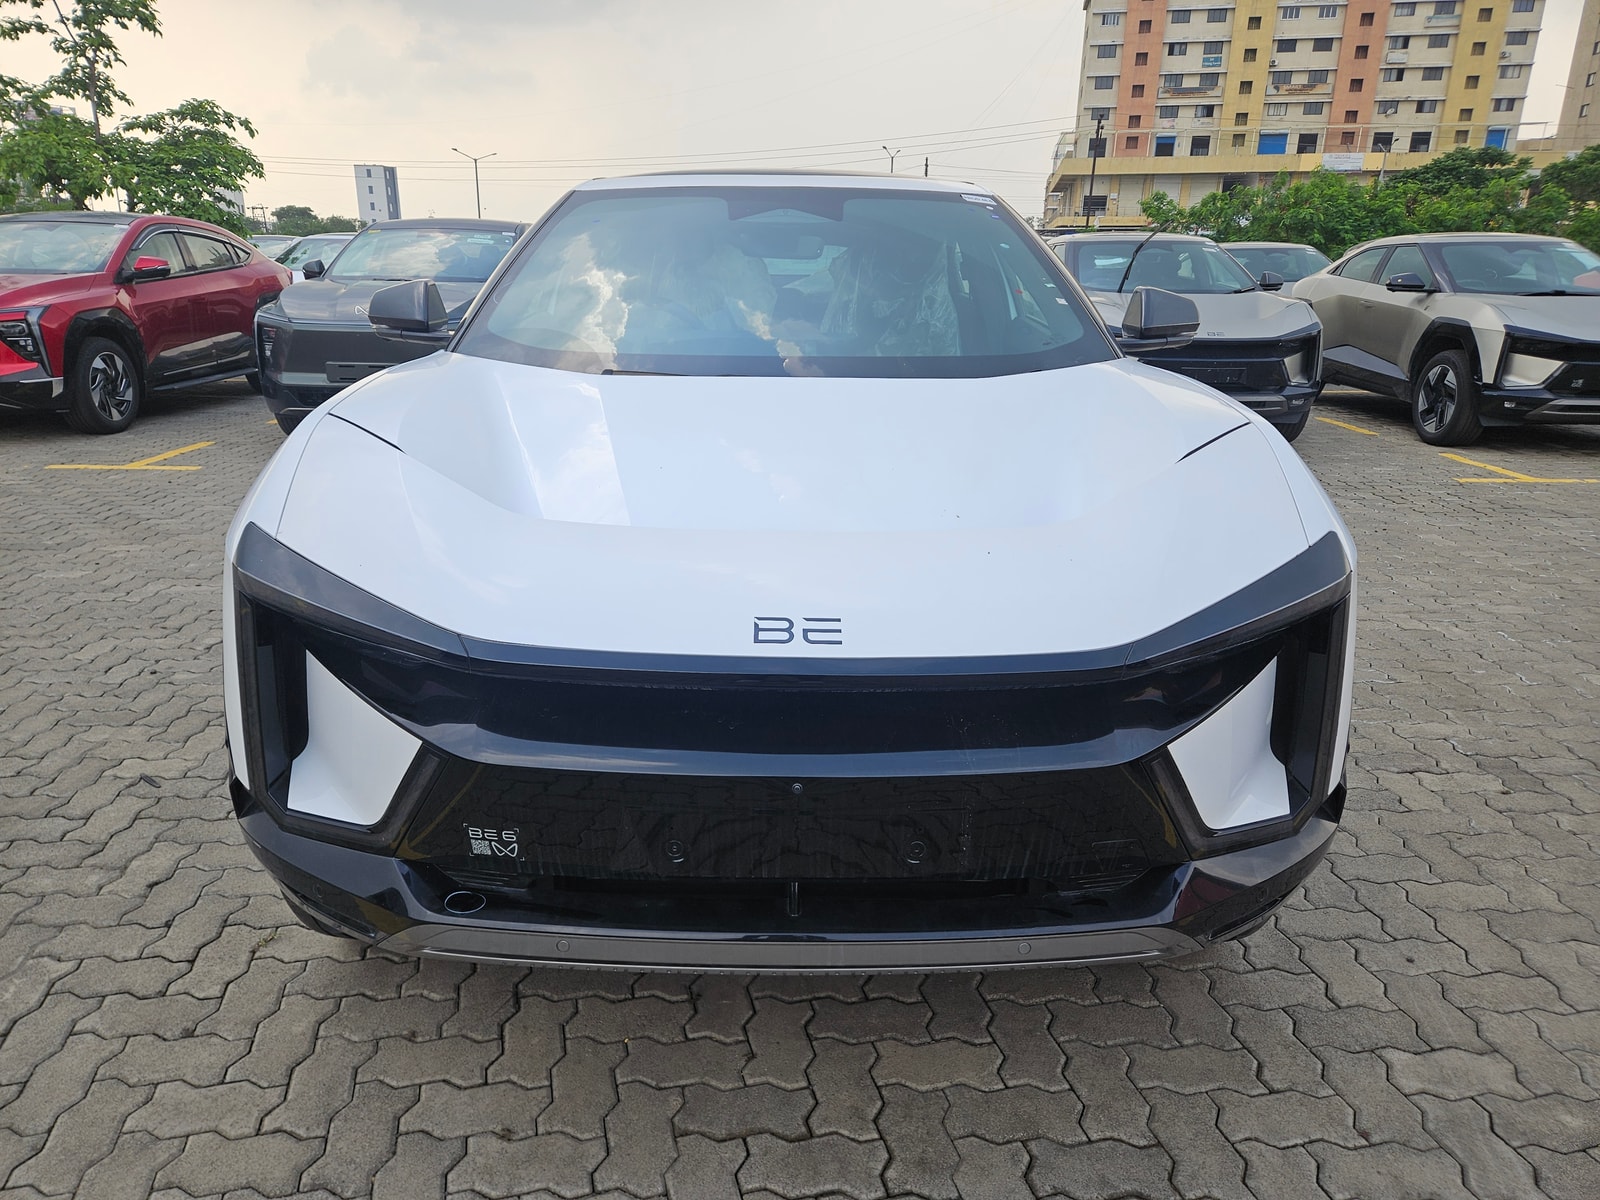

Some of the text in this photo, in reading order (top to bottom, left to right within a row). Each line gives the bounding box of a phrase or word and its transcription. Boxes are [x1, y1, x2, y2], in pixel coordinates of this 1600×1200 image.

[754, 616, 843, 645] BE
[468, 827, 517, 841] BE 6
